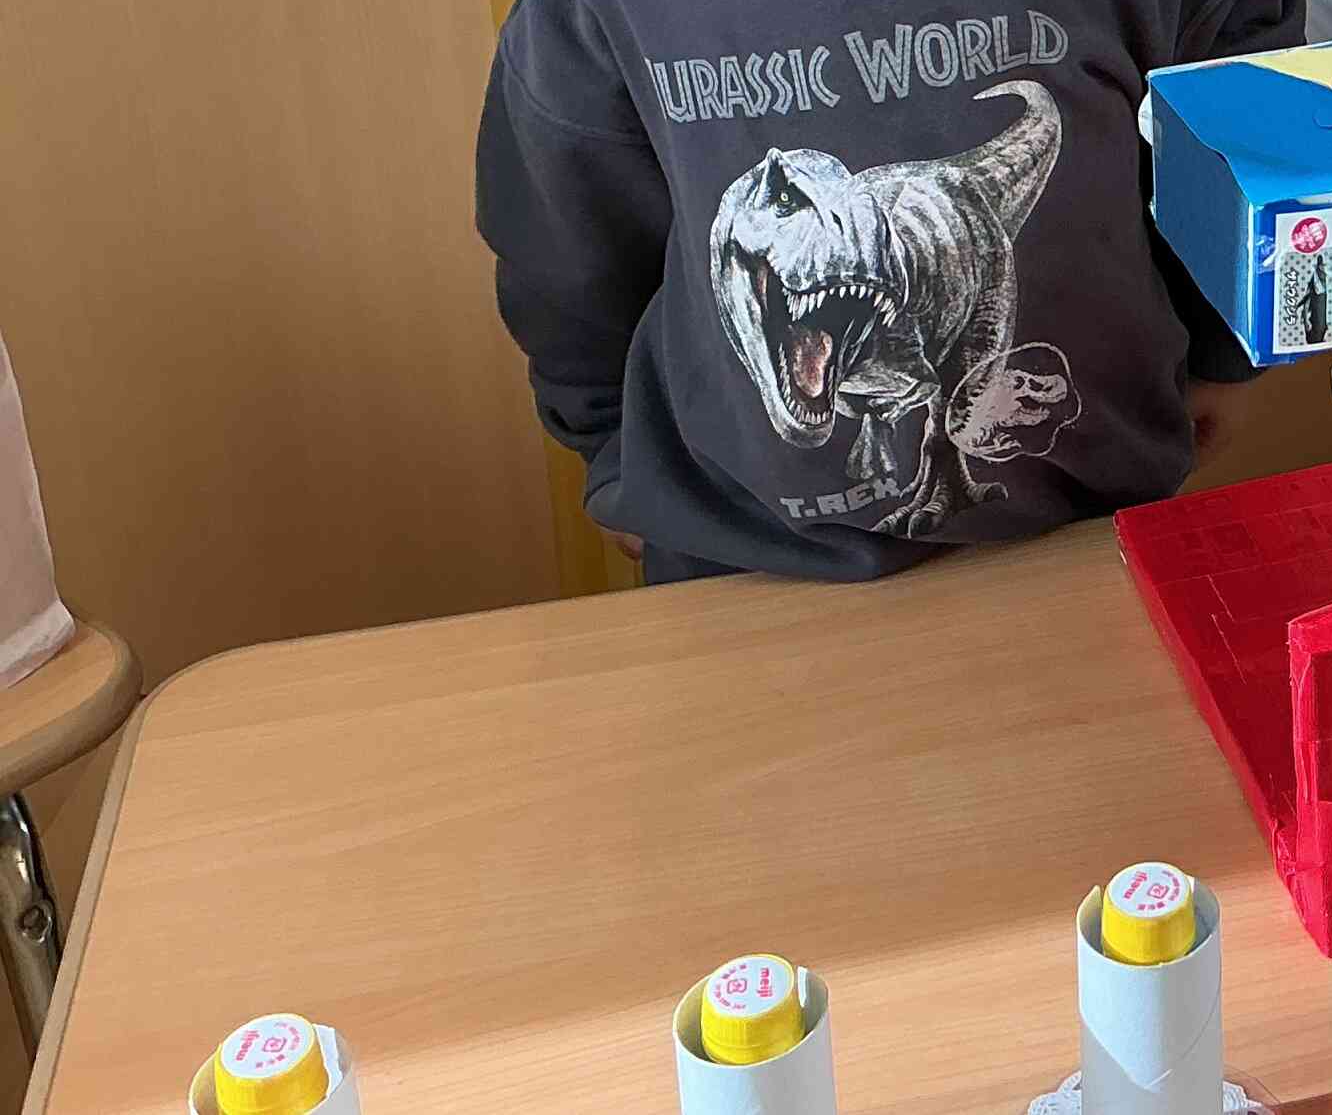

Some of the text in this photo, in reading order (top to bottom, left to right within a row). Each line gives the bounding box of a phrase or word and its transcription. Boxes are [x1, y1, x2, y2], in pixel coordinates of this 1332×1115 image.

[643, 8, 1070, 126] JURASSIC WORLD
[779, 478, 900, 521] T.REX
[1122, 869, 1149, 901] meiji
[756, 966, 774, 998] meiji
[235, 1029, 261, 1062] meiji
